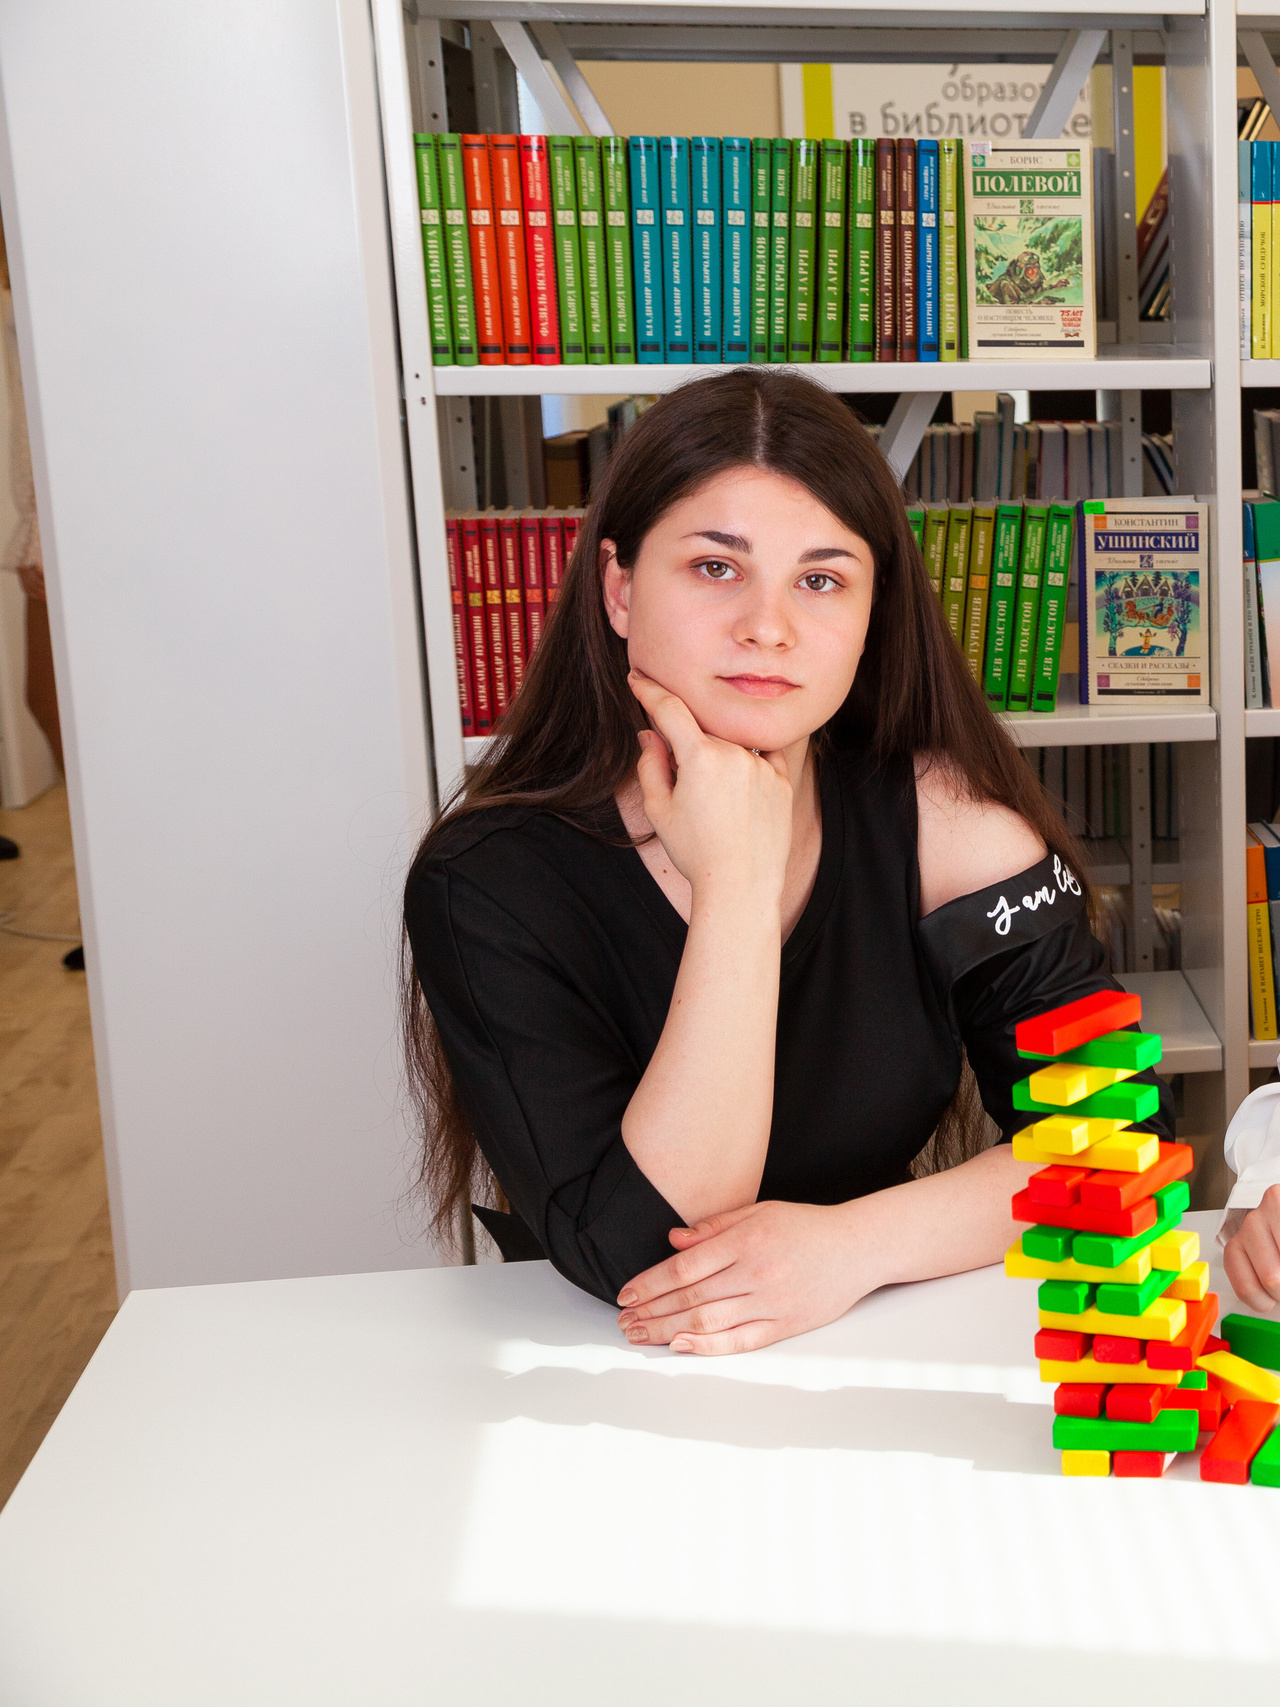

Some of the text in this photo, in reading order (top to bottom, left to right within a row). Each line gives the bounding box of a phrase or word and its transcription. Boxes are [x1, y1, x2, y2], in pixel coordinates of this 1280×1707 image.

[849, 101, 1091, 136] в библиоте
[942, 74, 1090, 107] образо
[975, 172, 1079, 193] ПОЛЕВОЙ
[1010, 156, 1043, 165] БОРИС
[427, 229, 447, 340] ЕЛЕНА ИЛЬИНА
[451, 229, 471, 340] ЕЛЕНА ИЛЬИНА
[533, 234, 549, 337] ФАЗИЛЬ ИСКАНДЕР
[563, 238, 577, 332] РЕДЬЯРД КИПЛИНГ
[587, 238, 600, 332] РЕДЬЯРД КИПЛИНГ
[613, 238, 627, 332] РЕДЬЯРД КИПЛИНГ
[642, 231, 653, 336] ВЛАДИМИР КОРОЛЕНКО
[671, 231, 682, 336] ВЛАДИМИР КОРОЛЕНКО
[702, 231, 711, 336] ВЛАДИМИР КОРОЛЕНКО
[732, 231, 741, 336] ВЛАДИМИР КОРОЛЕНКО
[755, 168, 766, 335] ИВАН КРЫЛОВ БАСНИ
[774, 168, 786, 335] ИВАН КРЫЛОВ БАСНИ
[797, 249, 809, 321] ЯН ЛАРРИ
[826, 249, 838, 321] ЯН ЛАРРИ
[859, 249, 870, 321] ЯН ЛАРРИ
[882, 230, 893, 336] МИХАИЛ ЛЕРМОНТОВ
[903, 230, 913, 336] МИХАИЛ ЛЕРМОНТОВ
[941, 234, 955, 286] ОЛЕША
[925, 300, 934, 338] ДМИТРИЙ
[940, 292, 955, 333] ЮРИЙ
[1097, 533, 1196, 549] УШИНСКИЙ
[1114, 518, 1178, 527] КОНСТАНТИН
[452, 614, 469, 709] АЛЕКСАНДР ПУШКИН
[472, 615, 488, 710] АЛЕКСАНДР ПУШКИН
[491, 613, 506, 707] АЛЕКСАНДР ПУШКИН
[510, 612, 522, 653] ПУШКИН
[968, 596, 982, 654] ТУРГЕНЕВ
[992, 600, 1007, 680] ЛЕВ ТОЛСТОЙ
[1016, 601, 1032, 681] ЛЕВ ТОЛСТОЙ
[1042, 599, 1058, 680] ЛЕВ ТОЛСТОЙ
[1022, 886, 1056, 911] am
[1258, 956, 1266, 987] НАСТАНЕТ
